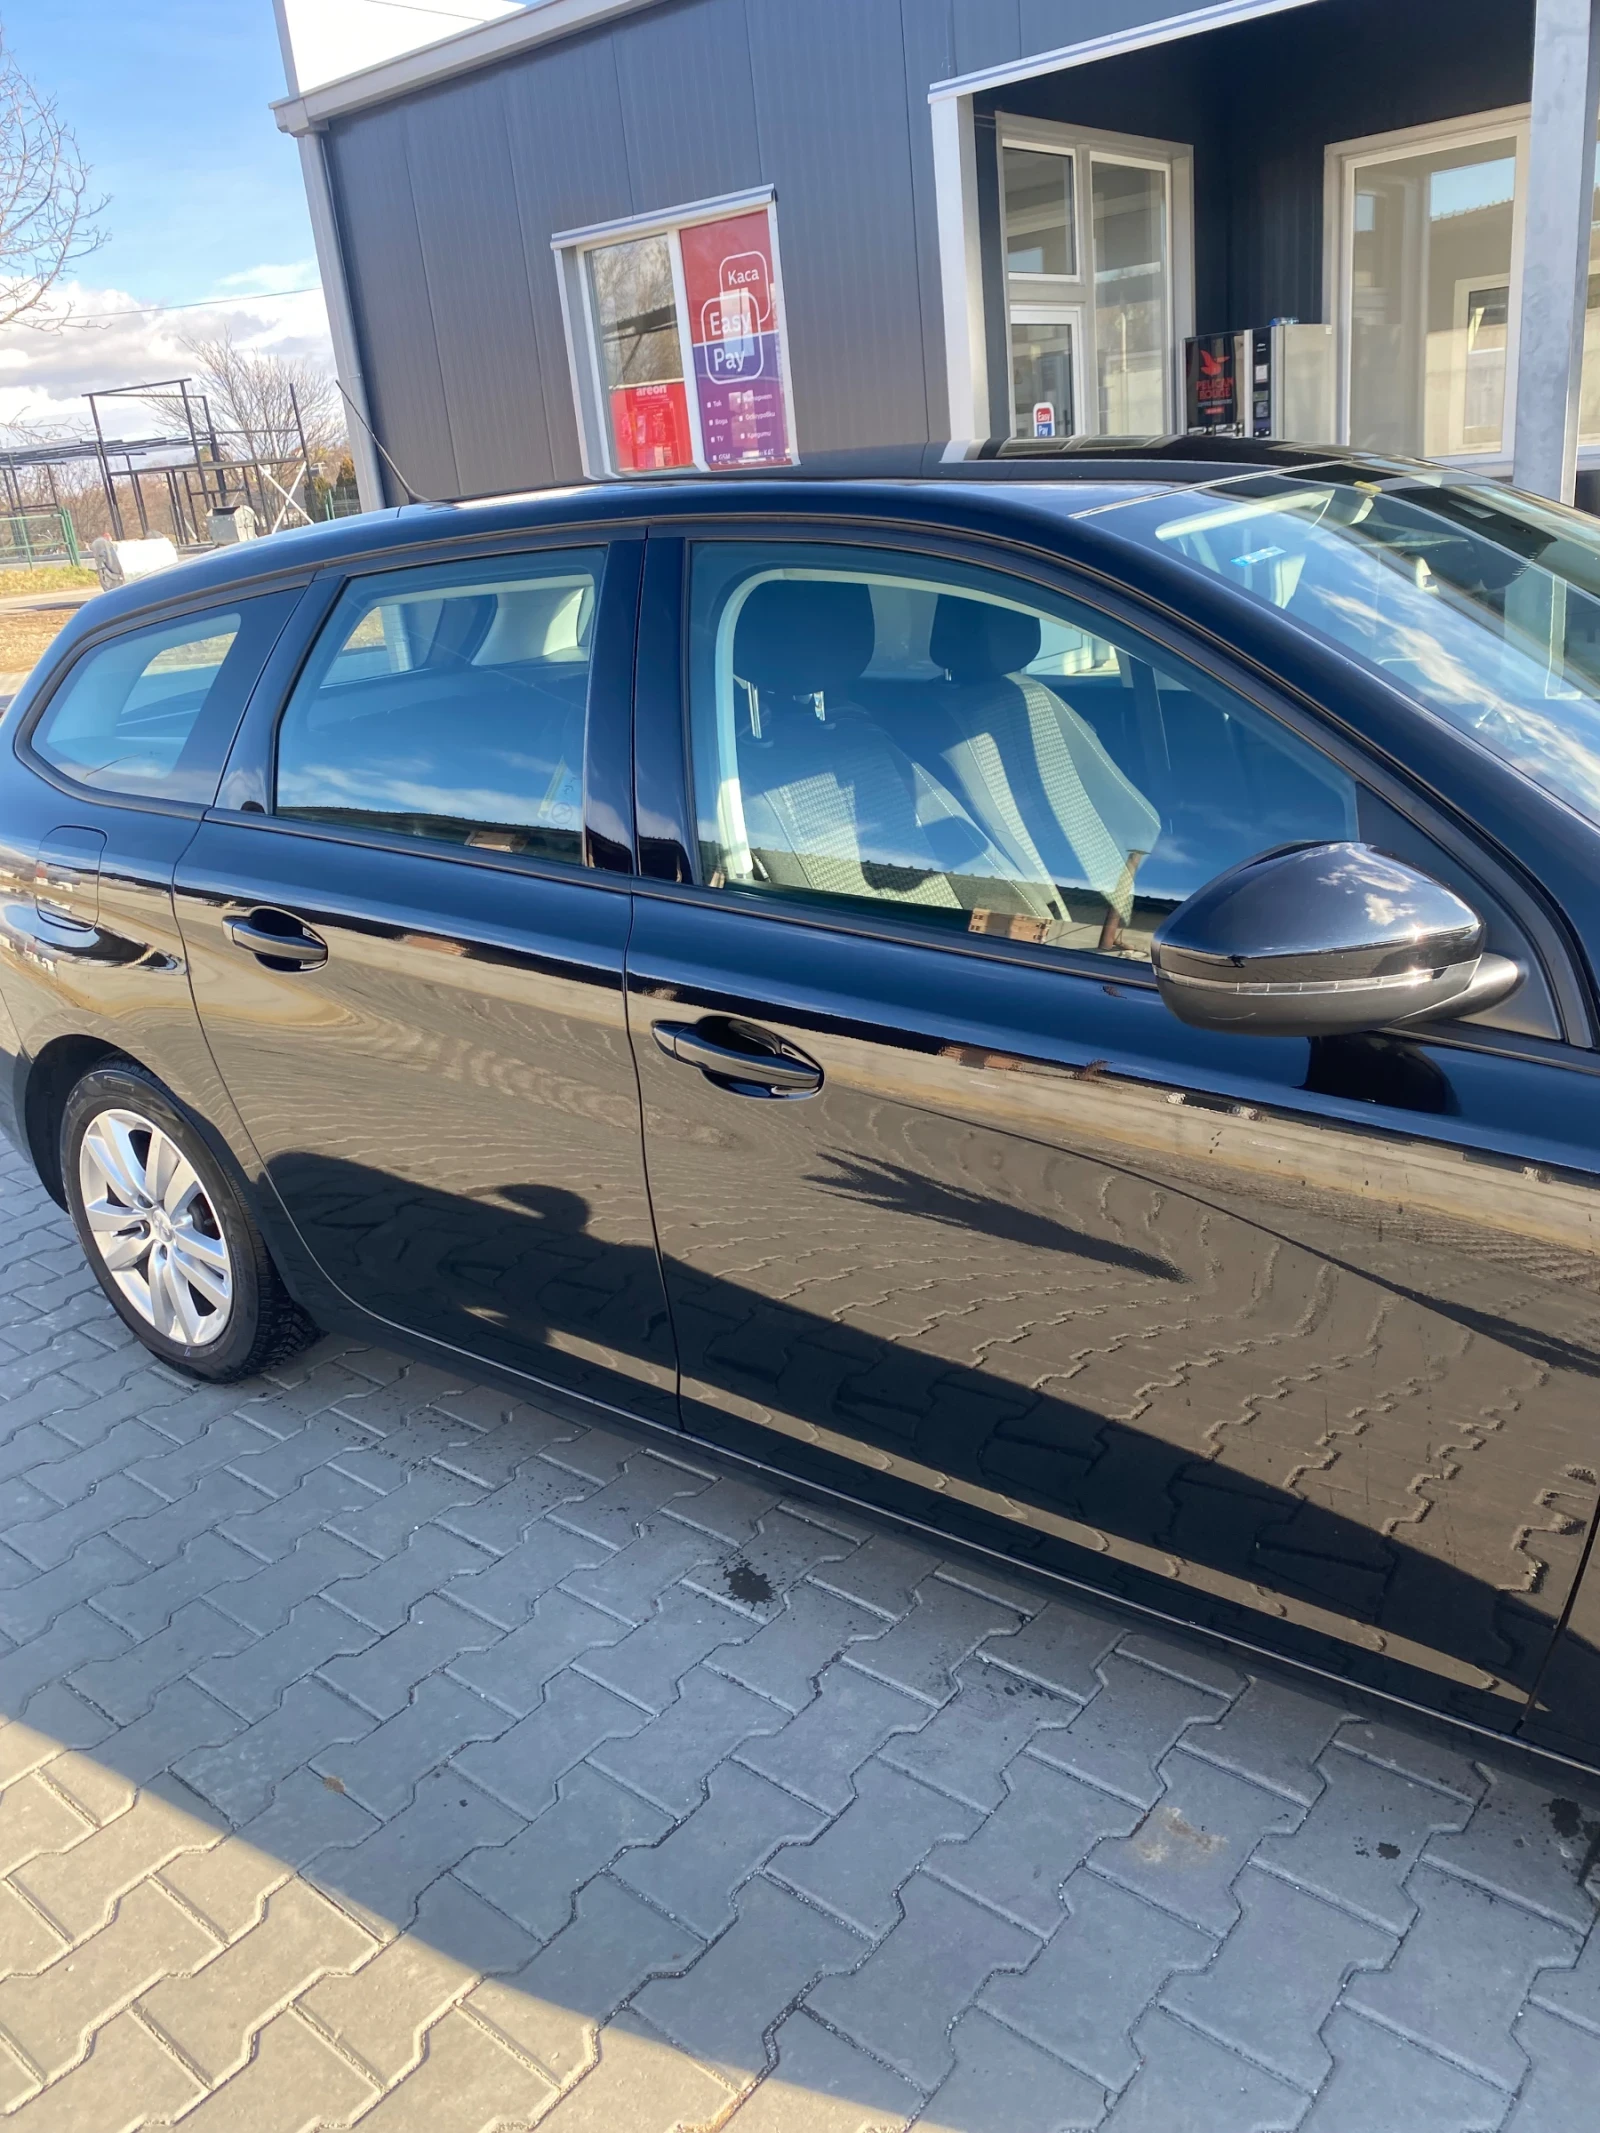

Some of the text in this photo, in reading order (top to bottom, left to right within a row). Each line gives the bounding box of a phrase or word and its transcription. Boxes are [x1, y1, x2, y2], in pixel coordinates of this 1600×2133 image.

[709, 311, 750, 336] Easy
[713, 348, 745, 372] Pay
[1196, 377, 1233, 390] PELICAN
[636, 384, 668, 397] areon
[1037, 411, 1051, 423] Easy
[1038, 425, 1049, 437] Pay
